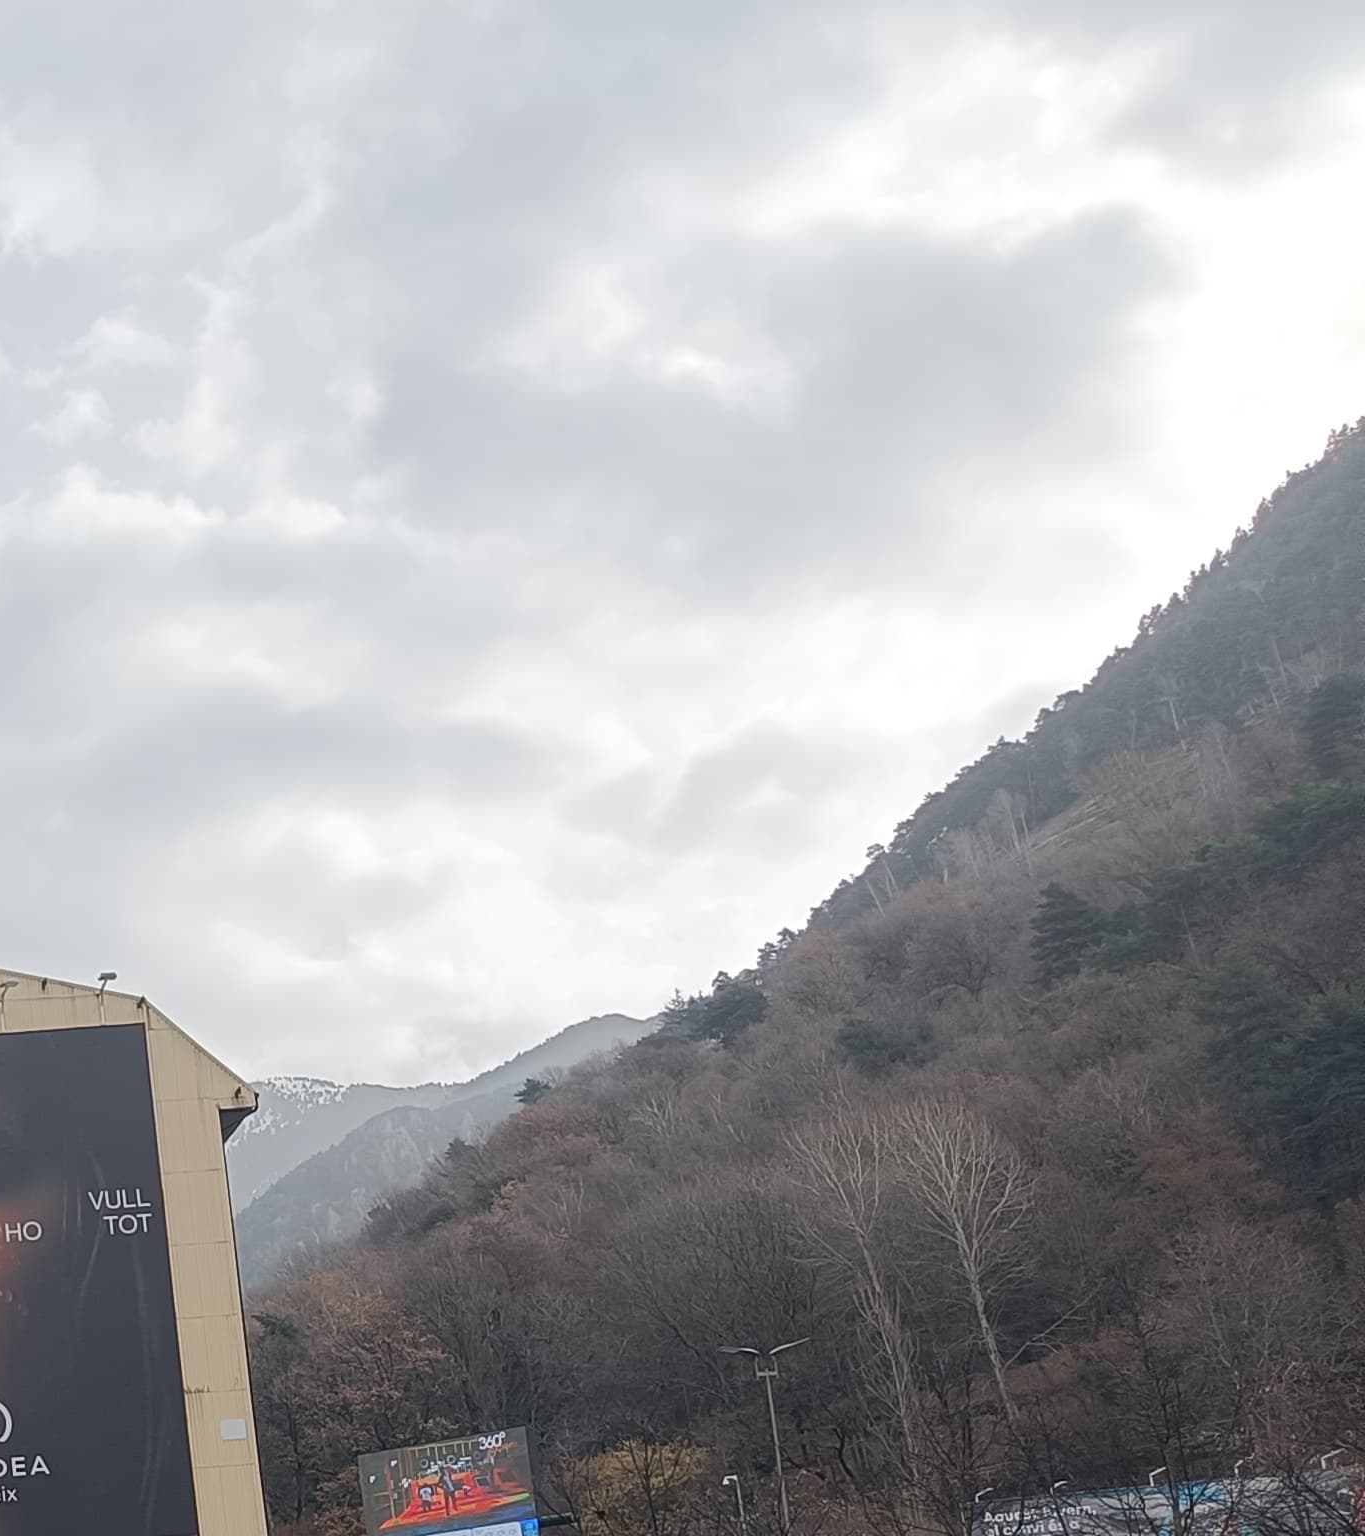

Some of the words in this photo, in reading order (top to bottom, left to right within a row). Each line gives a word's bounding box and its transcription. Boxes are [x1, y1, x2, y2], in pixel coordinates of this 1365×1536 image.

[87, 1187, 152, 1211] VULL
[4, 1220, 43, 1243] HO
[102, 1212, 153, 1236] TOT
